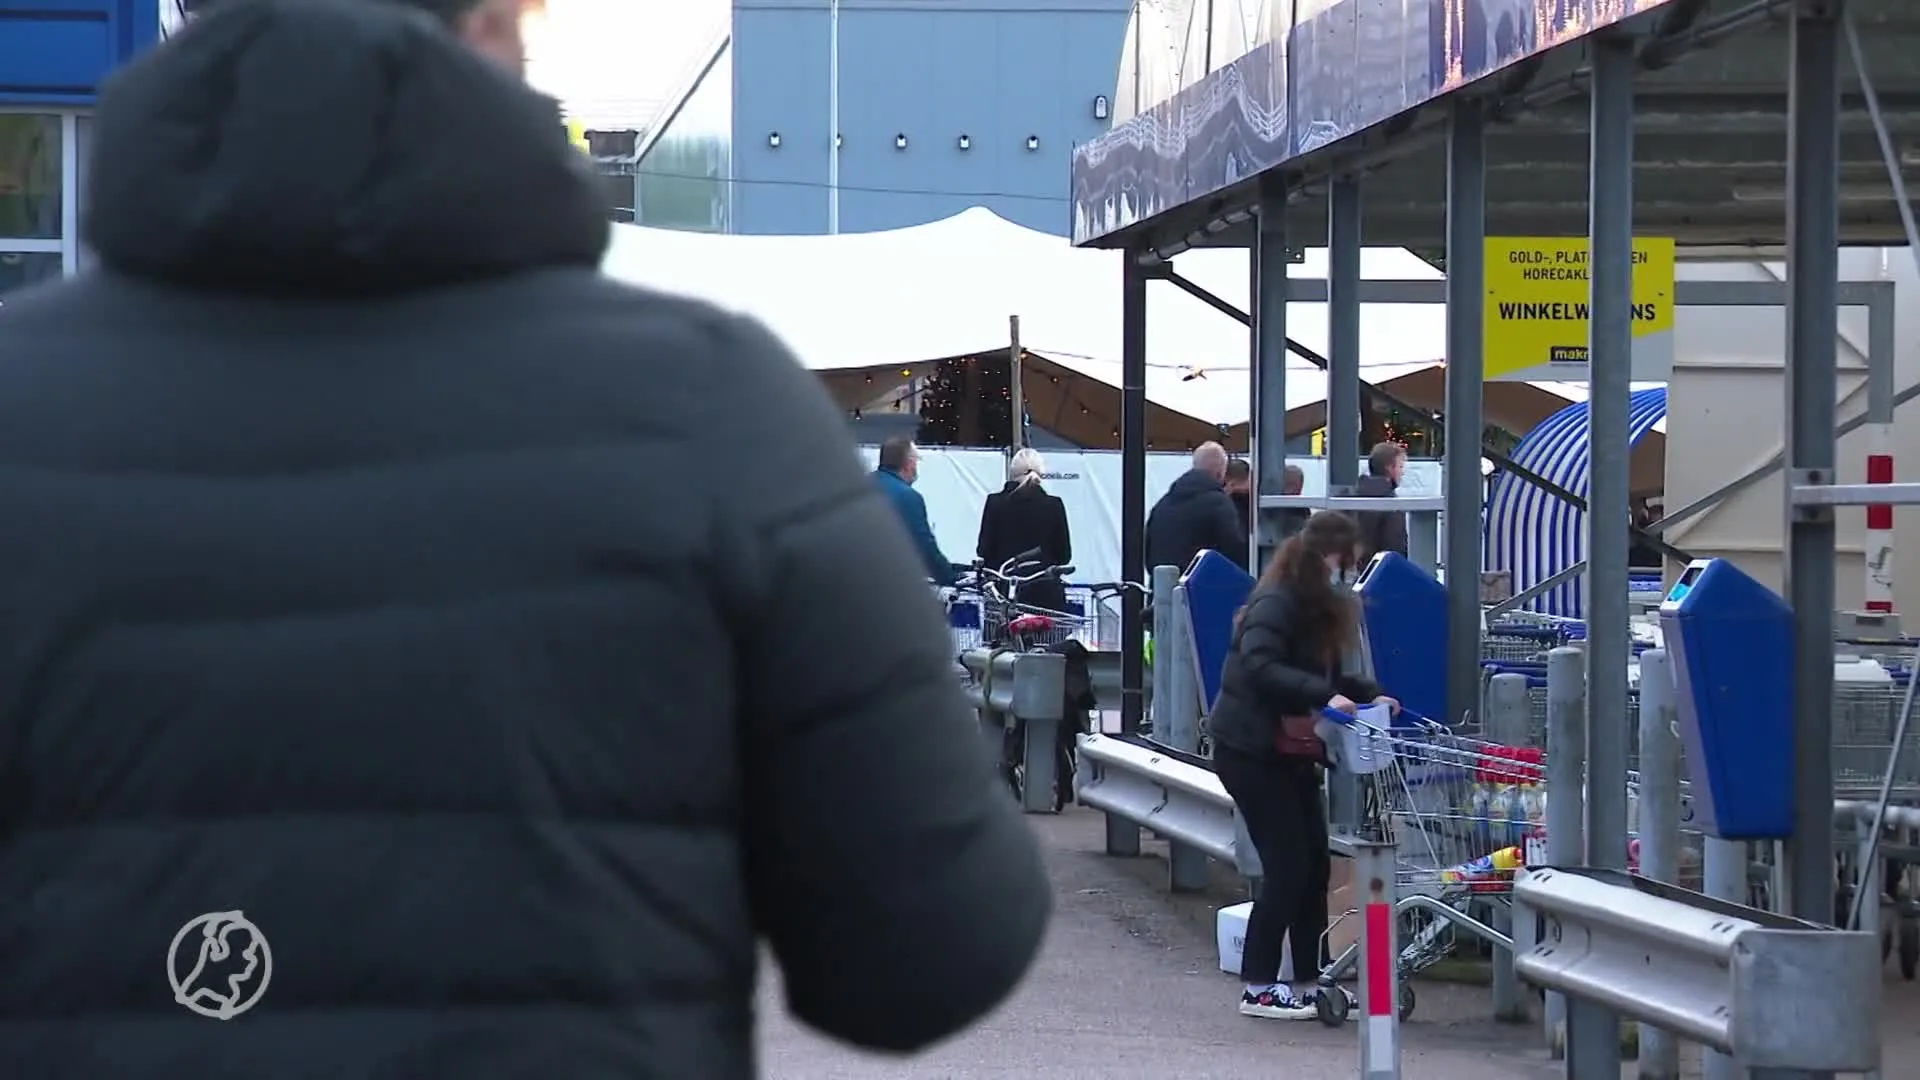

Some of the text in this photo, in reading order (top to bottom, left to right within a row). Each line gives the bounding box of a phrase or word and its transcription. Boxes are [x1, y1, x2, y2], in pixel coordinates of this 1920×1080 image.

[1509, 250, 1552, 265] GOLD-,
[1556, 251, 1589, 264] PLAT
[1523, 268, 1590, 281] HORECAKL
[1499, 302, 1657, 321] WINKELWNS
[1554, 349, 1590, 361] makr
